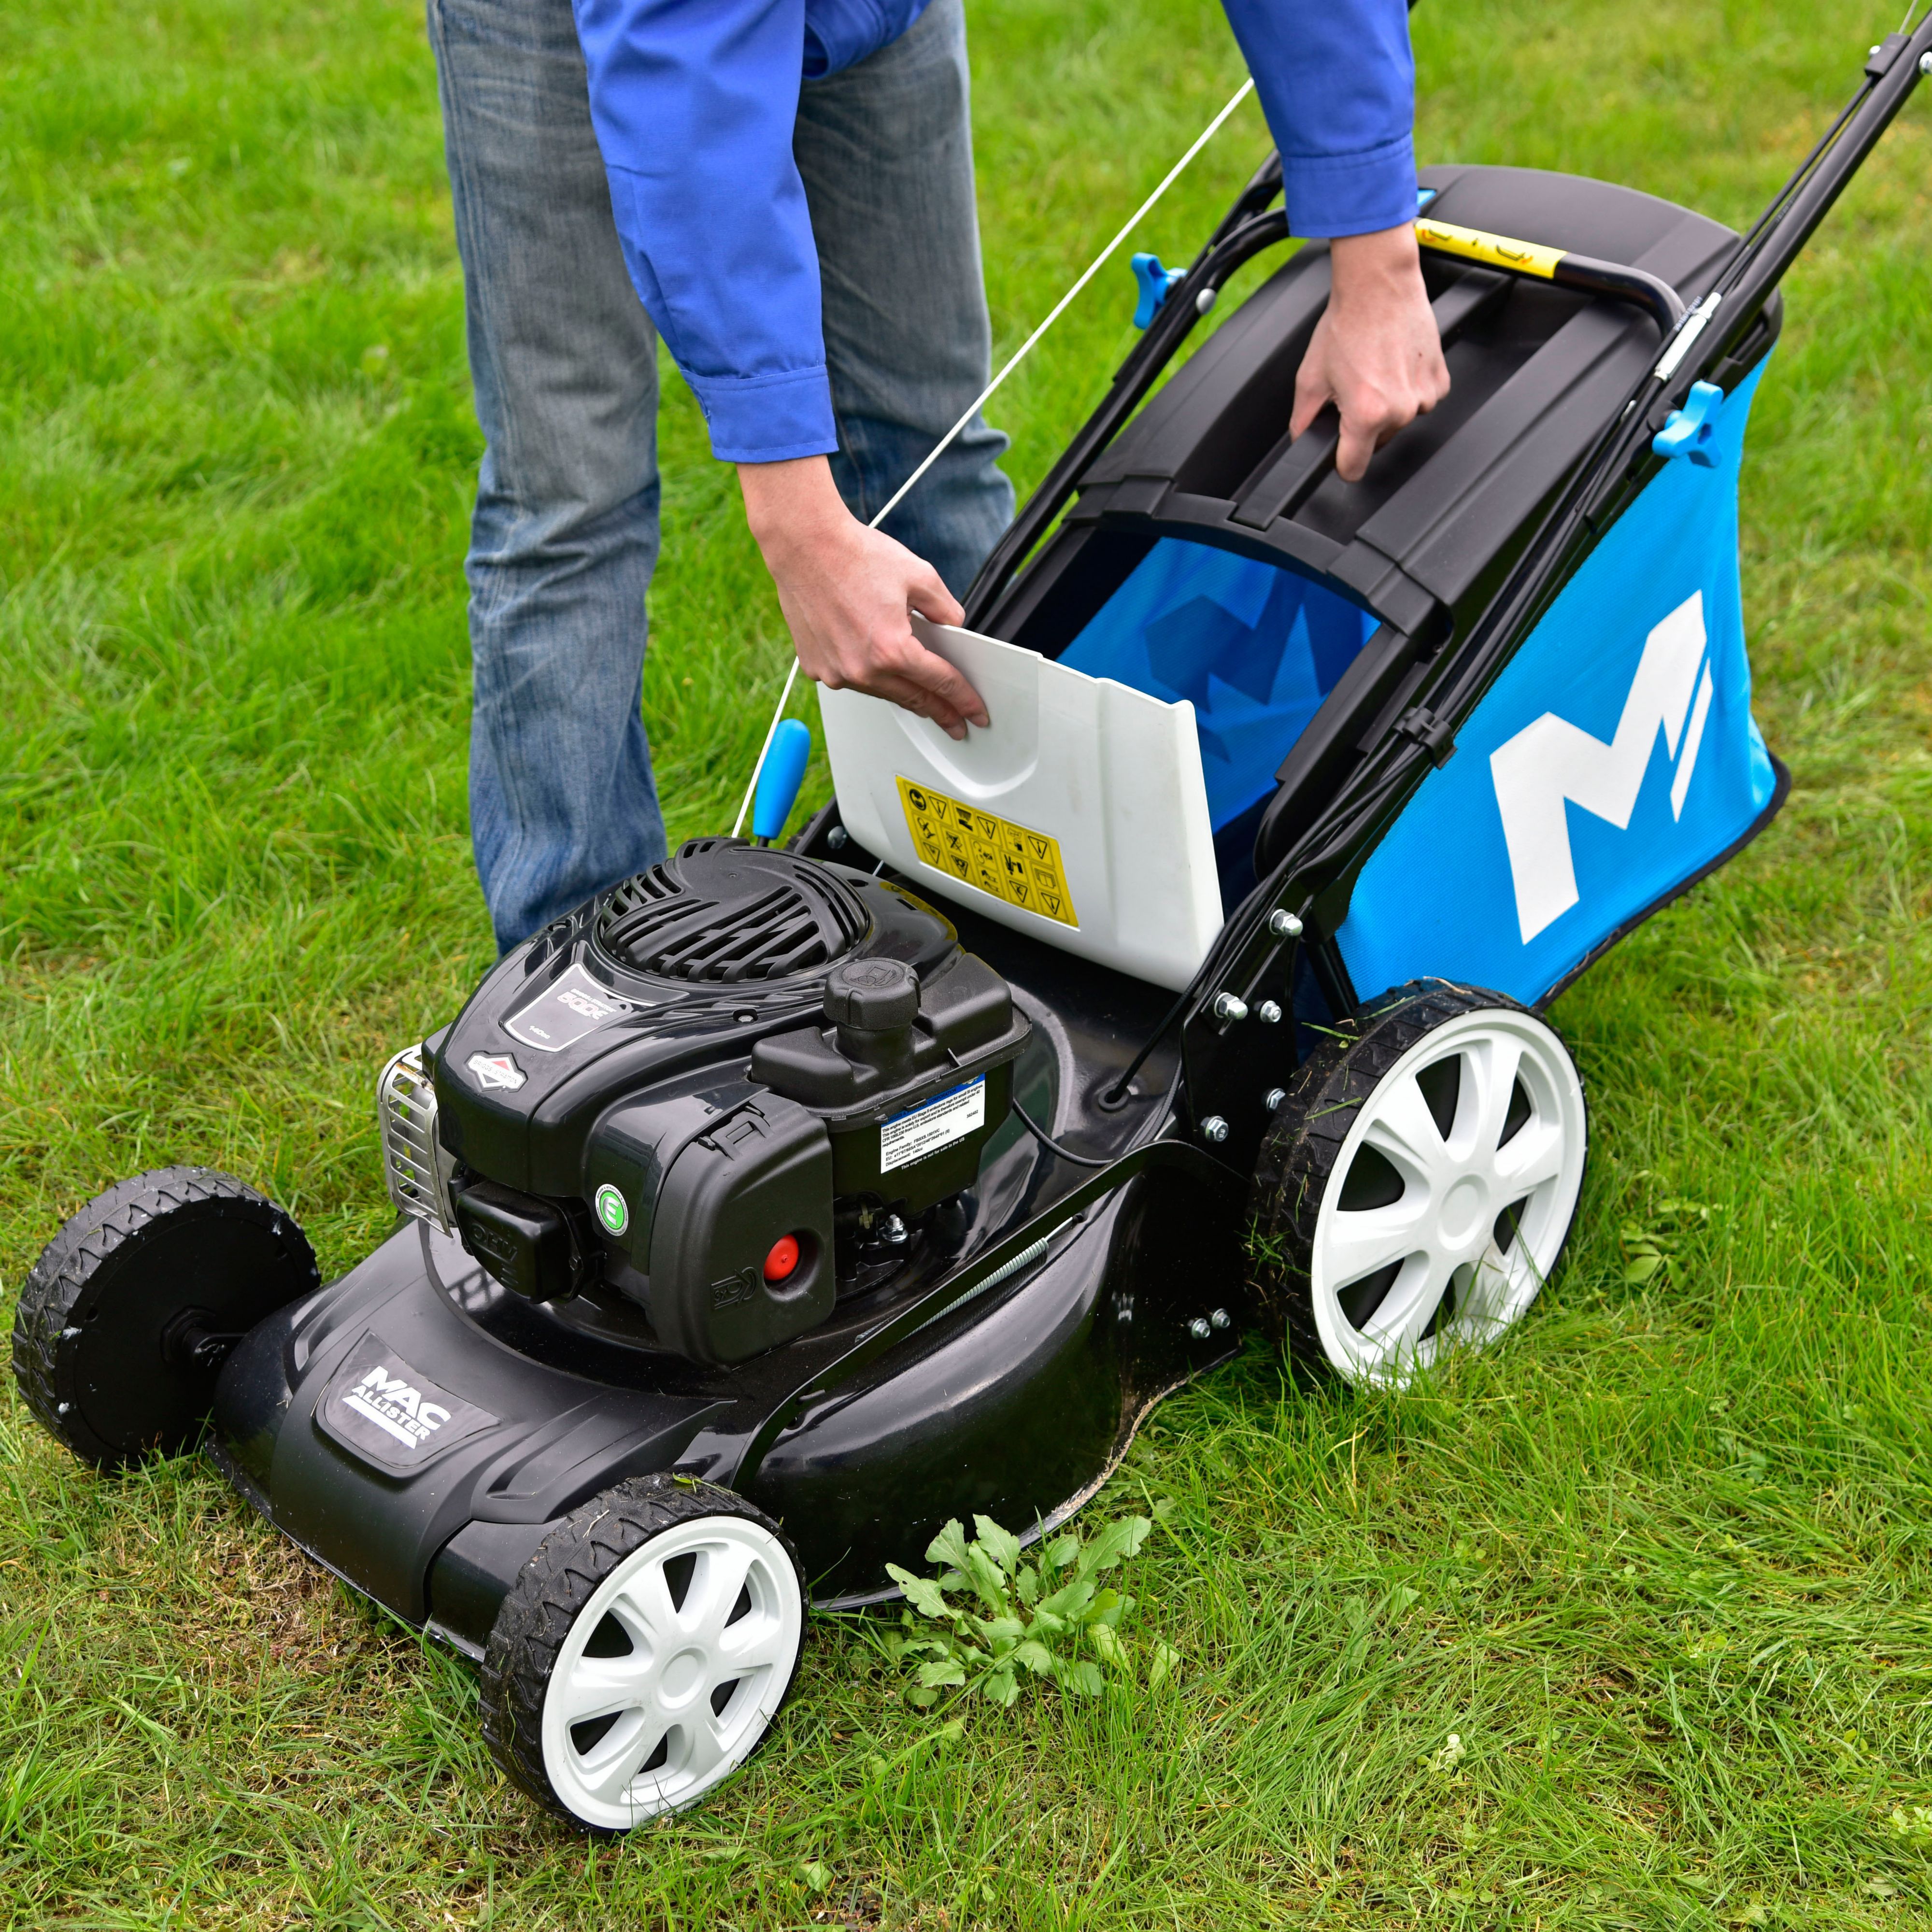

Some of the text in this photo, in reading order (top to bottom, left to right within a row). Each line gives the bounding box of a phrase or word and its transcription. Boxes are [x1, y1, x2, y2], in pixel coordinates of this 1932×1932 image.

[473, 1059, 493, 1072] BRIGGS
[928, 1088, 957, 1104] CORPORATION
[941, 1102, 954, 1111] therefore
[955, 1095, 966, 1104] exempt
[929, 1102, 945, 1111] emissions
[920, 1116, 936, 1125] emissions
[937, 1108, 952, 1118] standards
[882, 1135, 904, 1147] requirements.
[886, 1152, 910, 1166] Displacement:
[361, 1365, 452, 1430] MAC
